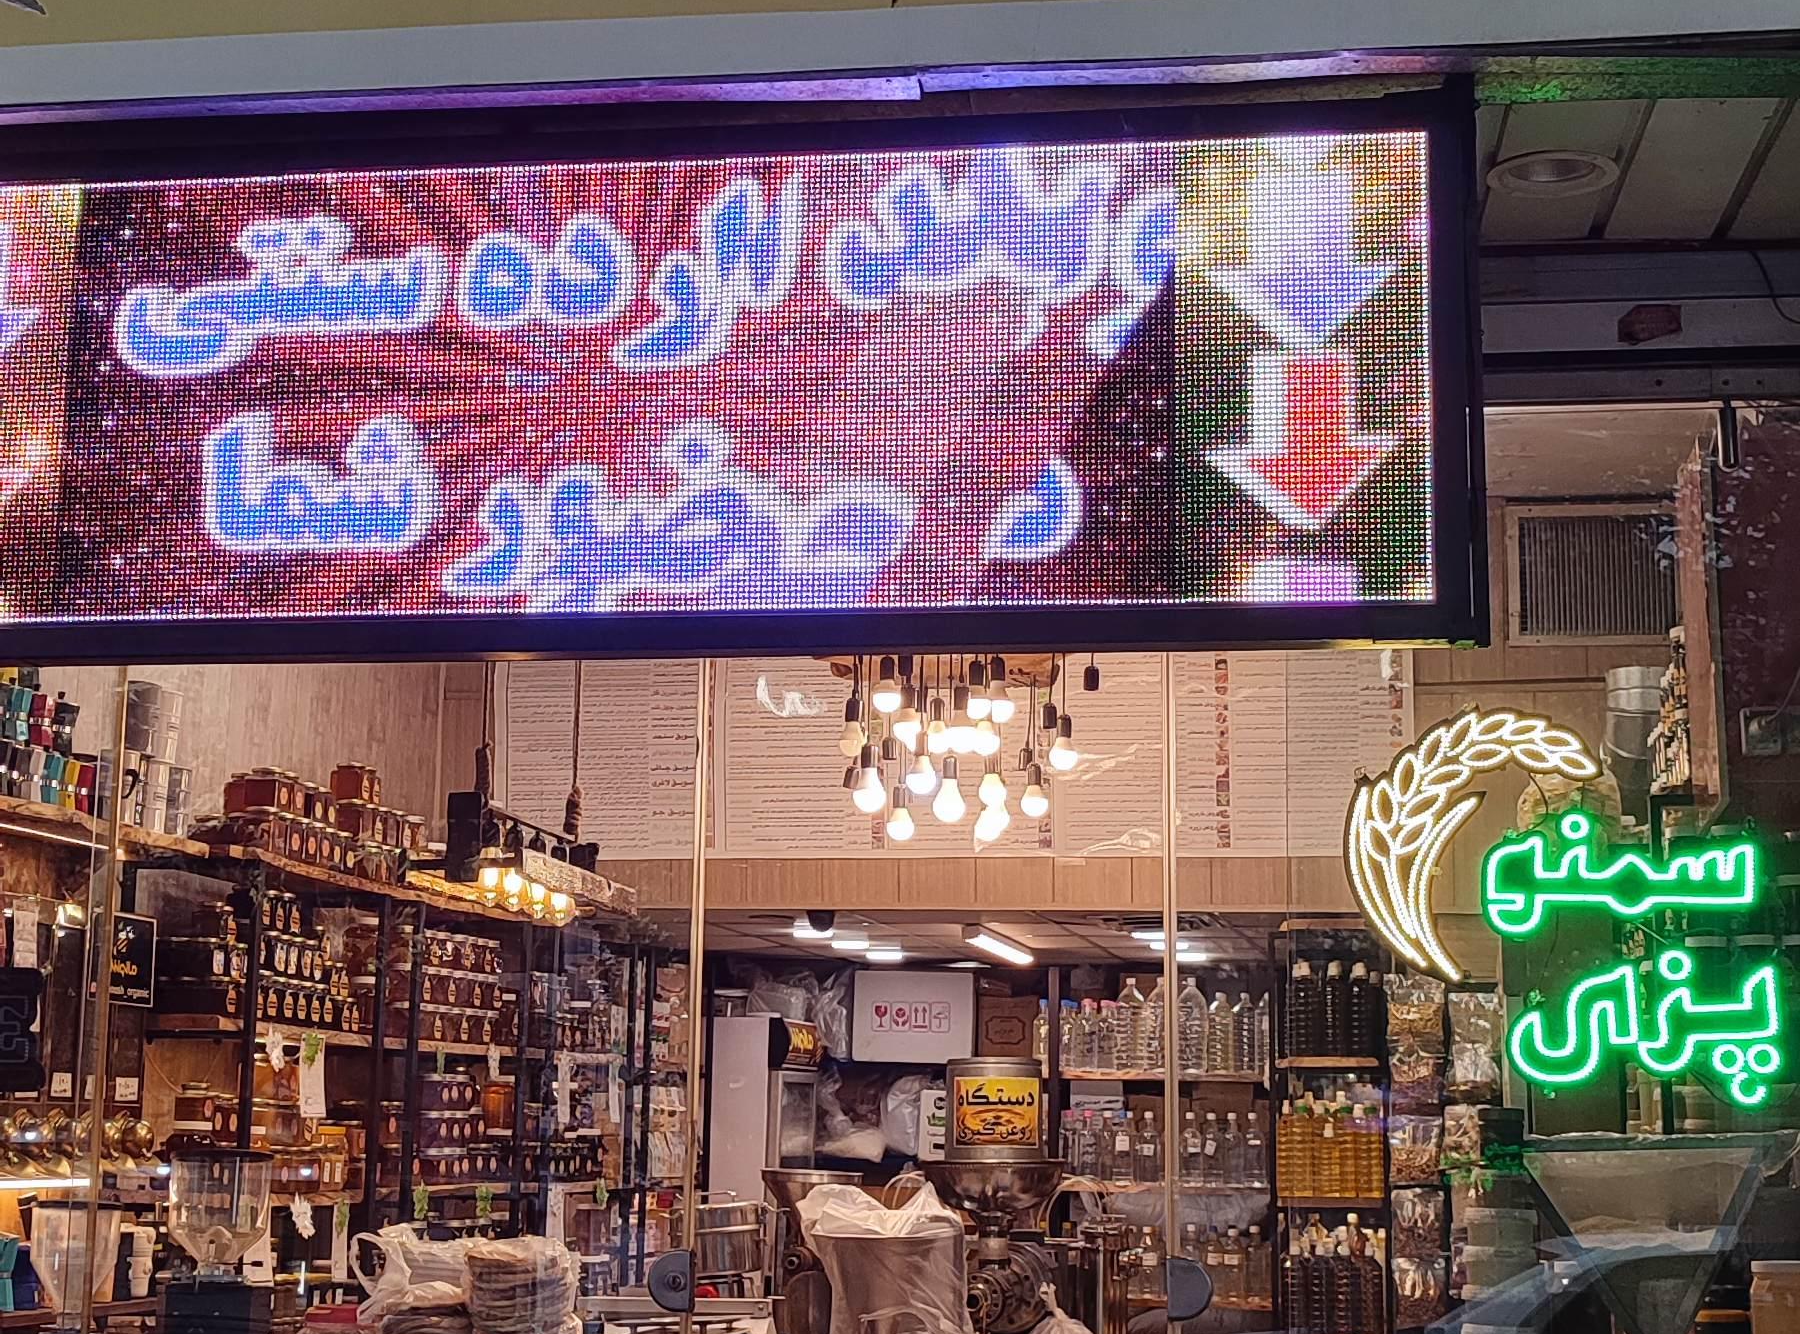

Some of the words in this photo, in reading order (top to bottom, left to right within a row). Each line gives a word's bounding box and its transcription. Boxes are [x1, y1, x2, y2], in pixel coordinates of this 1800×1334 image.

[113, 214, 449, 377] سنتی
[202, 409, 440, 552] شما
[1486, 813, 1755, 933] سمنو
[958, 1083, 1036, 1107] دستگاه
[1511, 949, 1780, 1105] پزی
